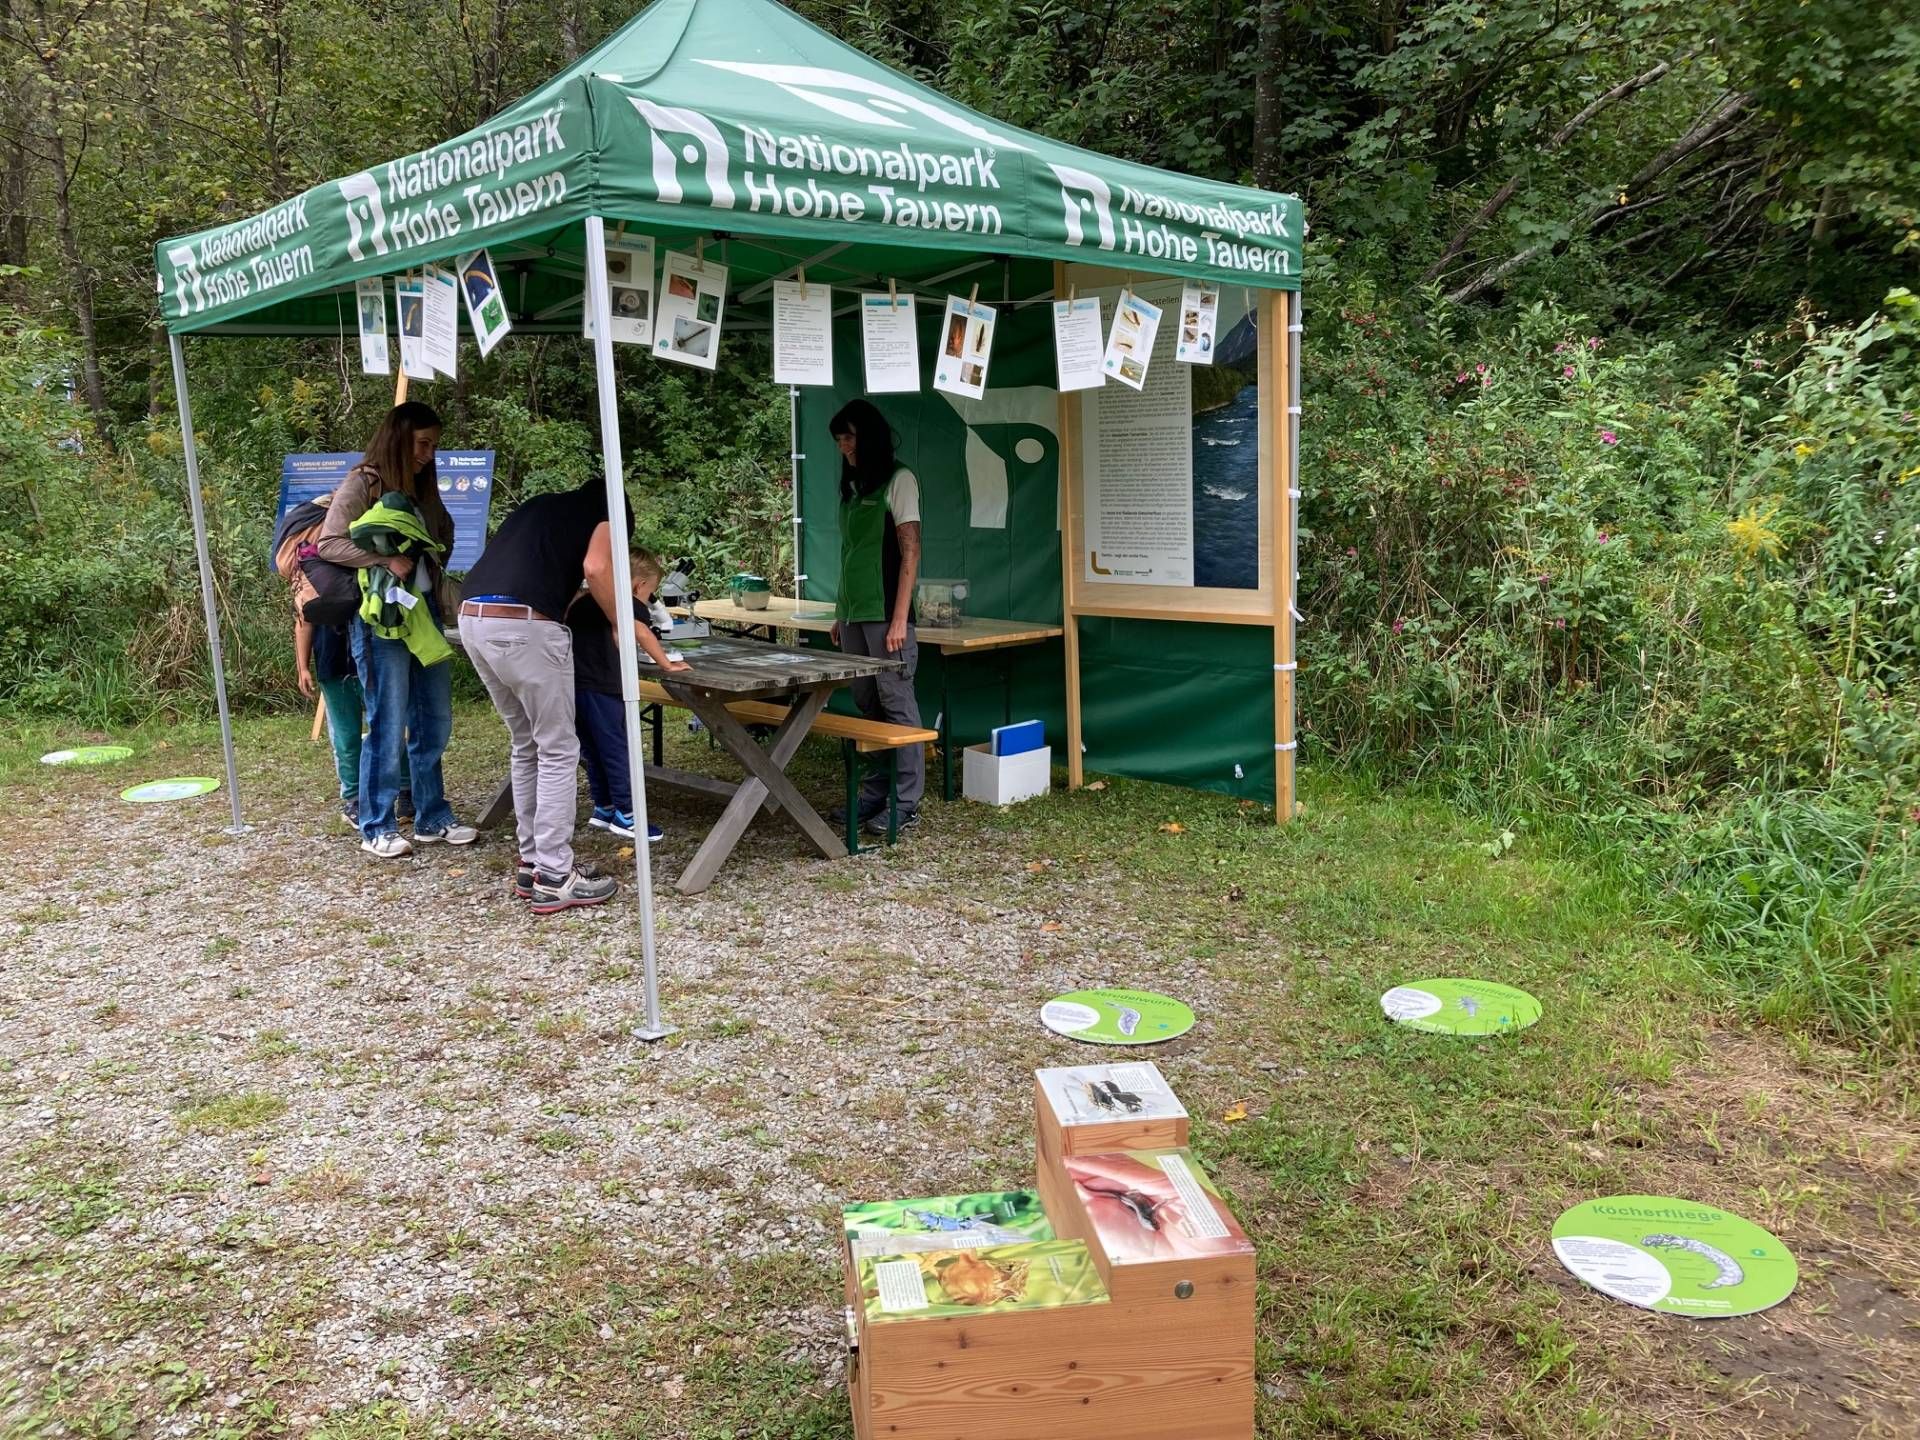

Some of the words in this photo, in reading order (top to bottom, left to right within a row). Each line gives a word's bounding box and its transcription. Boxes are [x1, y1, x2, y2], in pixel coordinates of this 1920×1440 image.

[200, 197, 310, 270] Nationalpark
[390, 199, 461, 251] Hohe
[463, 171, 567, 230] Tauern
[744, 171, 865, 222] Hohe
[868, 184, 1002, 235] Tauern
[204, 267, 250, 308] Hohe
[249, 244, 314, 291] Tauern
[1121, 217, 1198, 263] Hohe
[1200, 231, 1290, 275] Tauern
[1592, 1204, 1723, 1222] Köcherfliege
